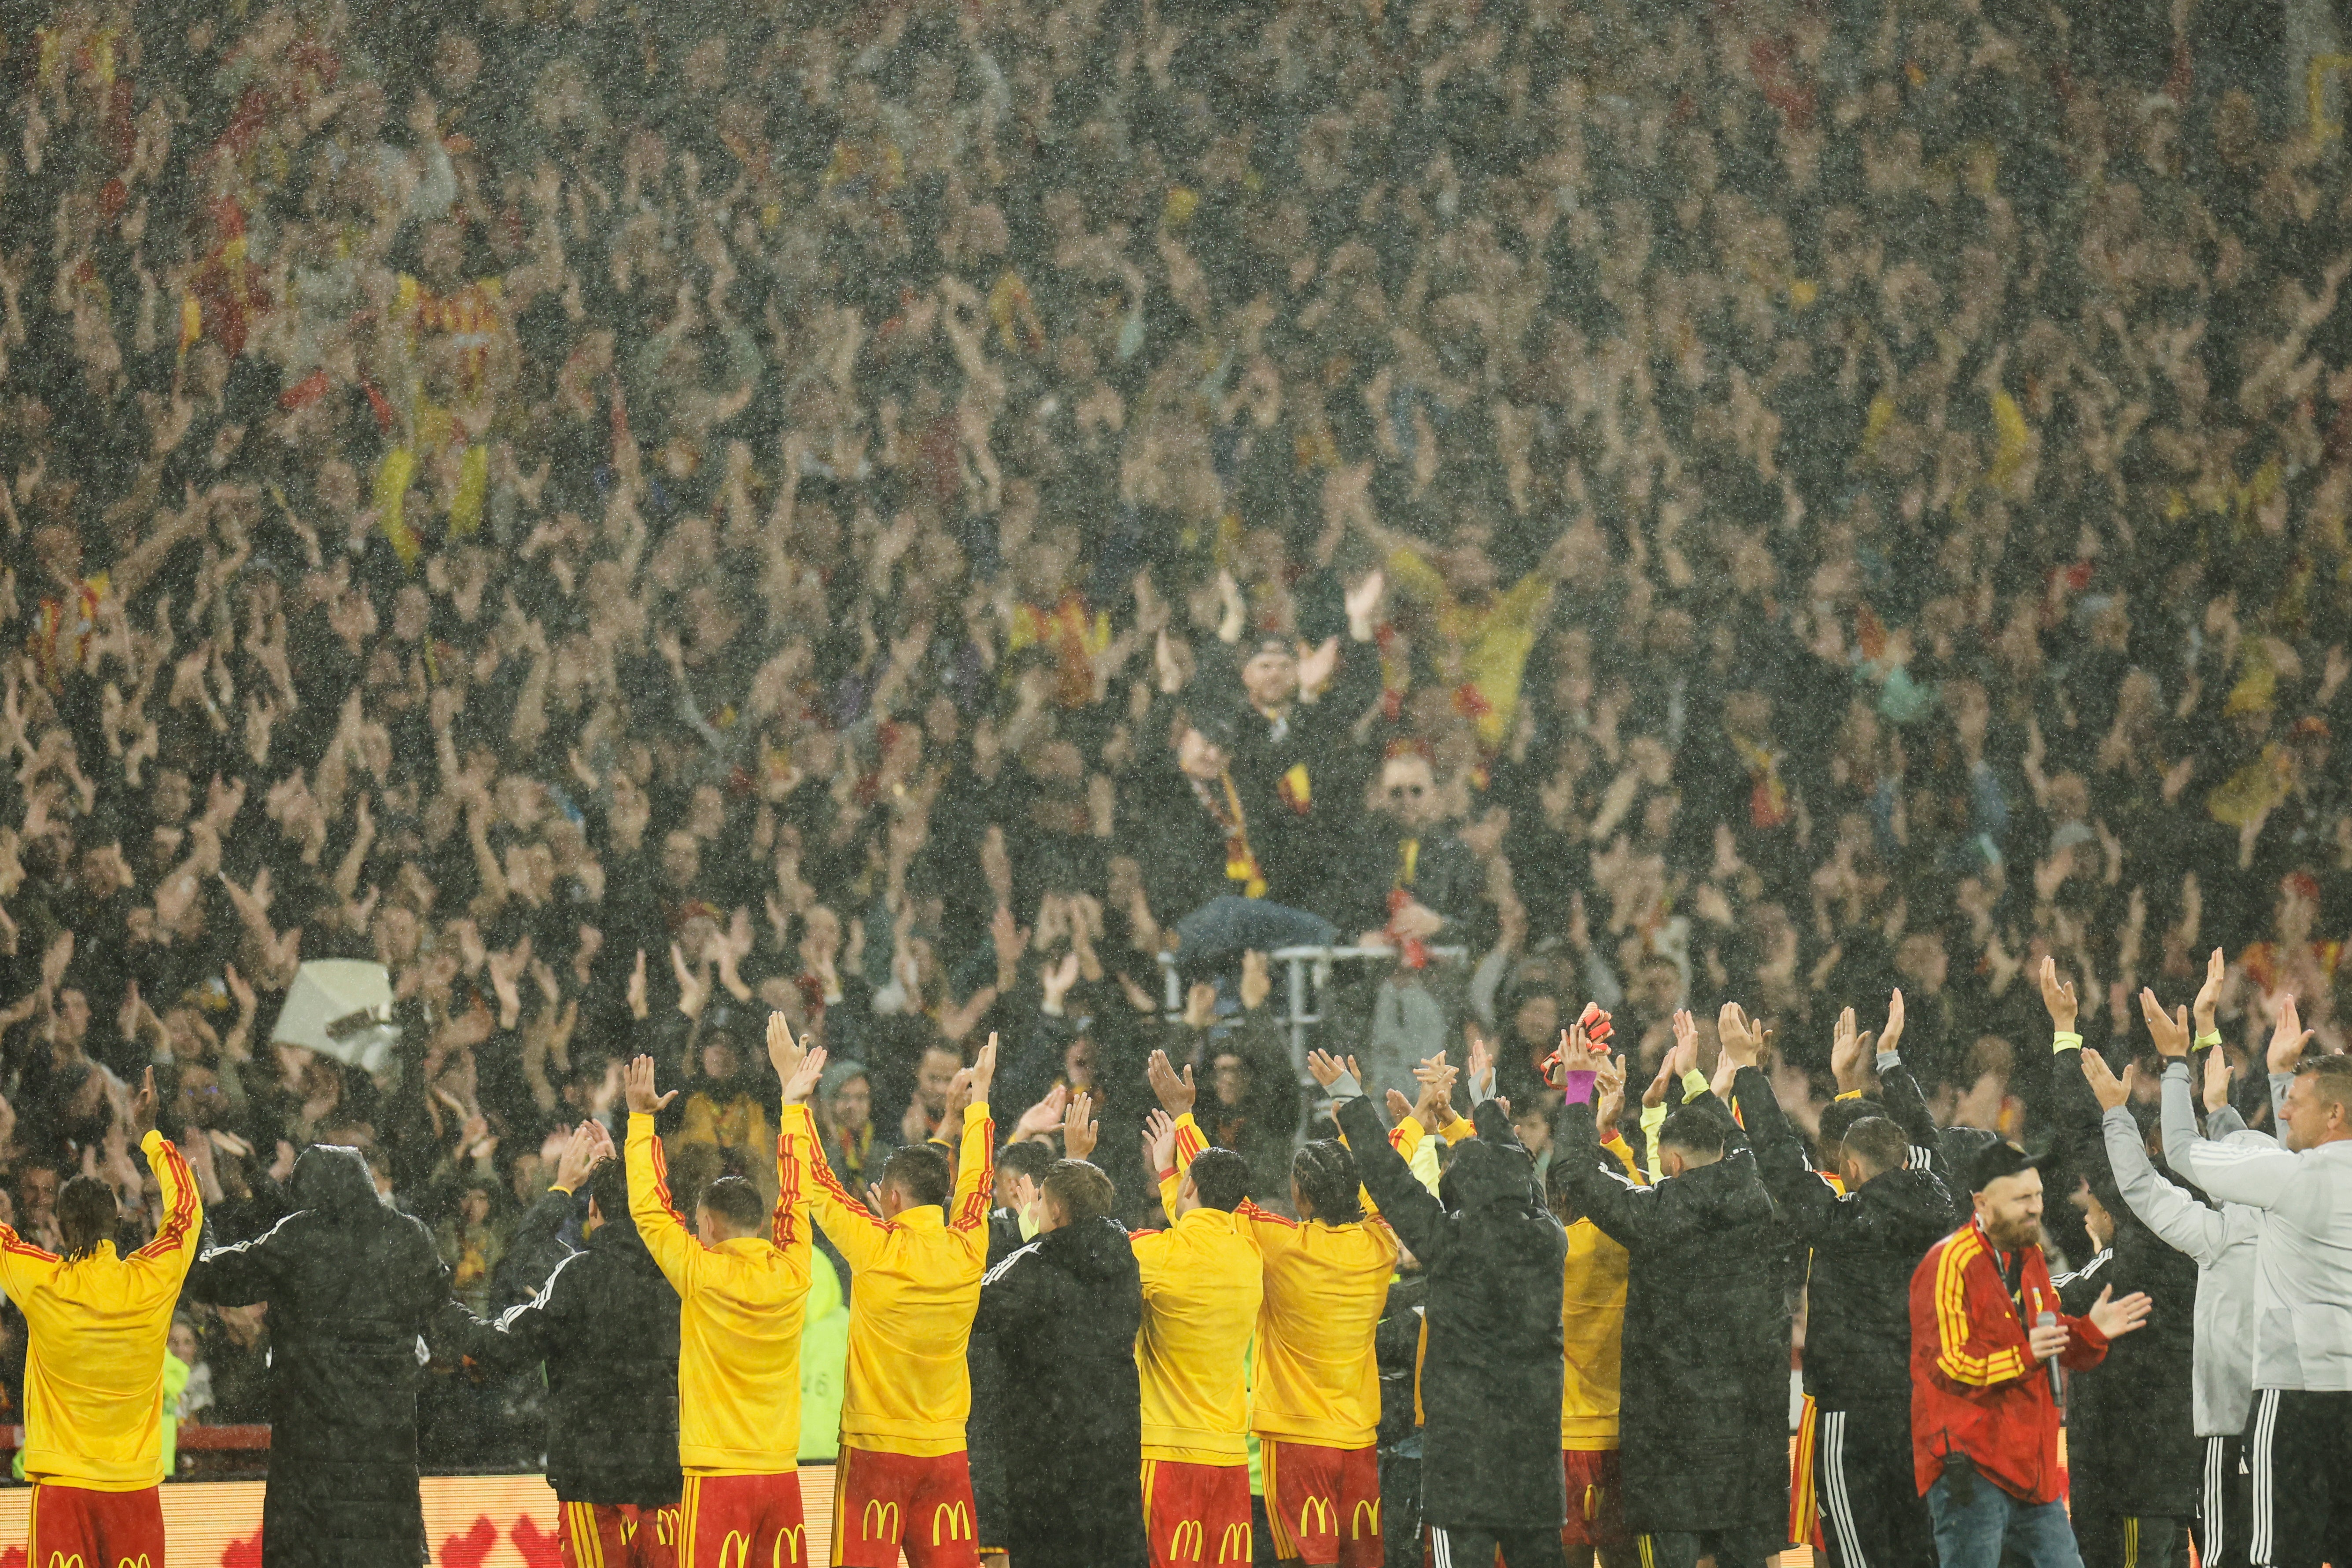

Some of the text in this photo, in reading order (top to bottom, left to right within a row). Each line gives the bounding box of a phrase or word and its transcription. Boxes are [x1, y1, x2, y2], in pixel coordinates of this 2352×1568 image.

[863, 1499, 899, 1544] M
[933, 1500, 971, 1546] M
[1300, 1496, 1338, 1537] M
[773, 1524, 805, 1568] M
[1169, 1520, 1202, 1562] M
[1218, 1522, 1253, 1564] M
